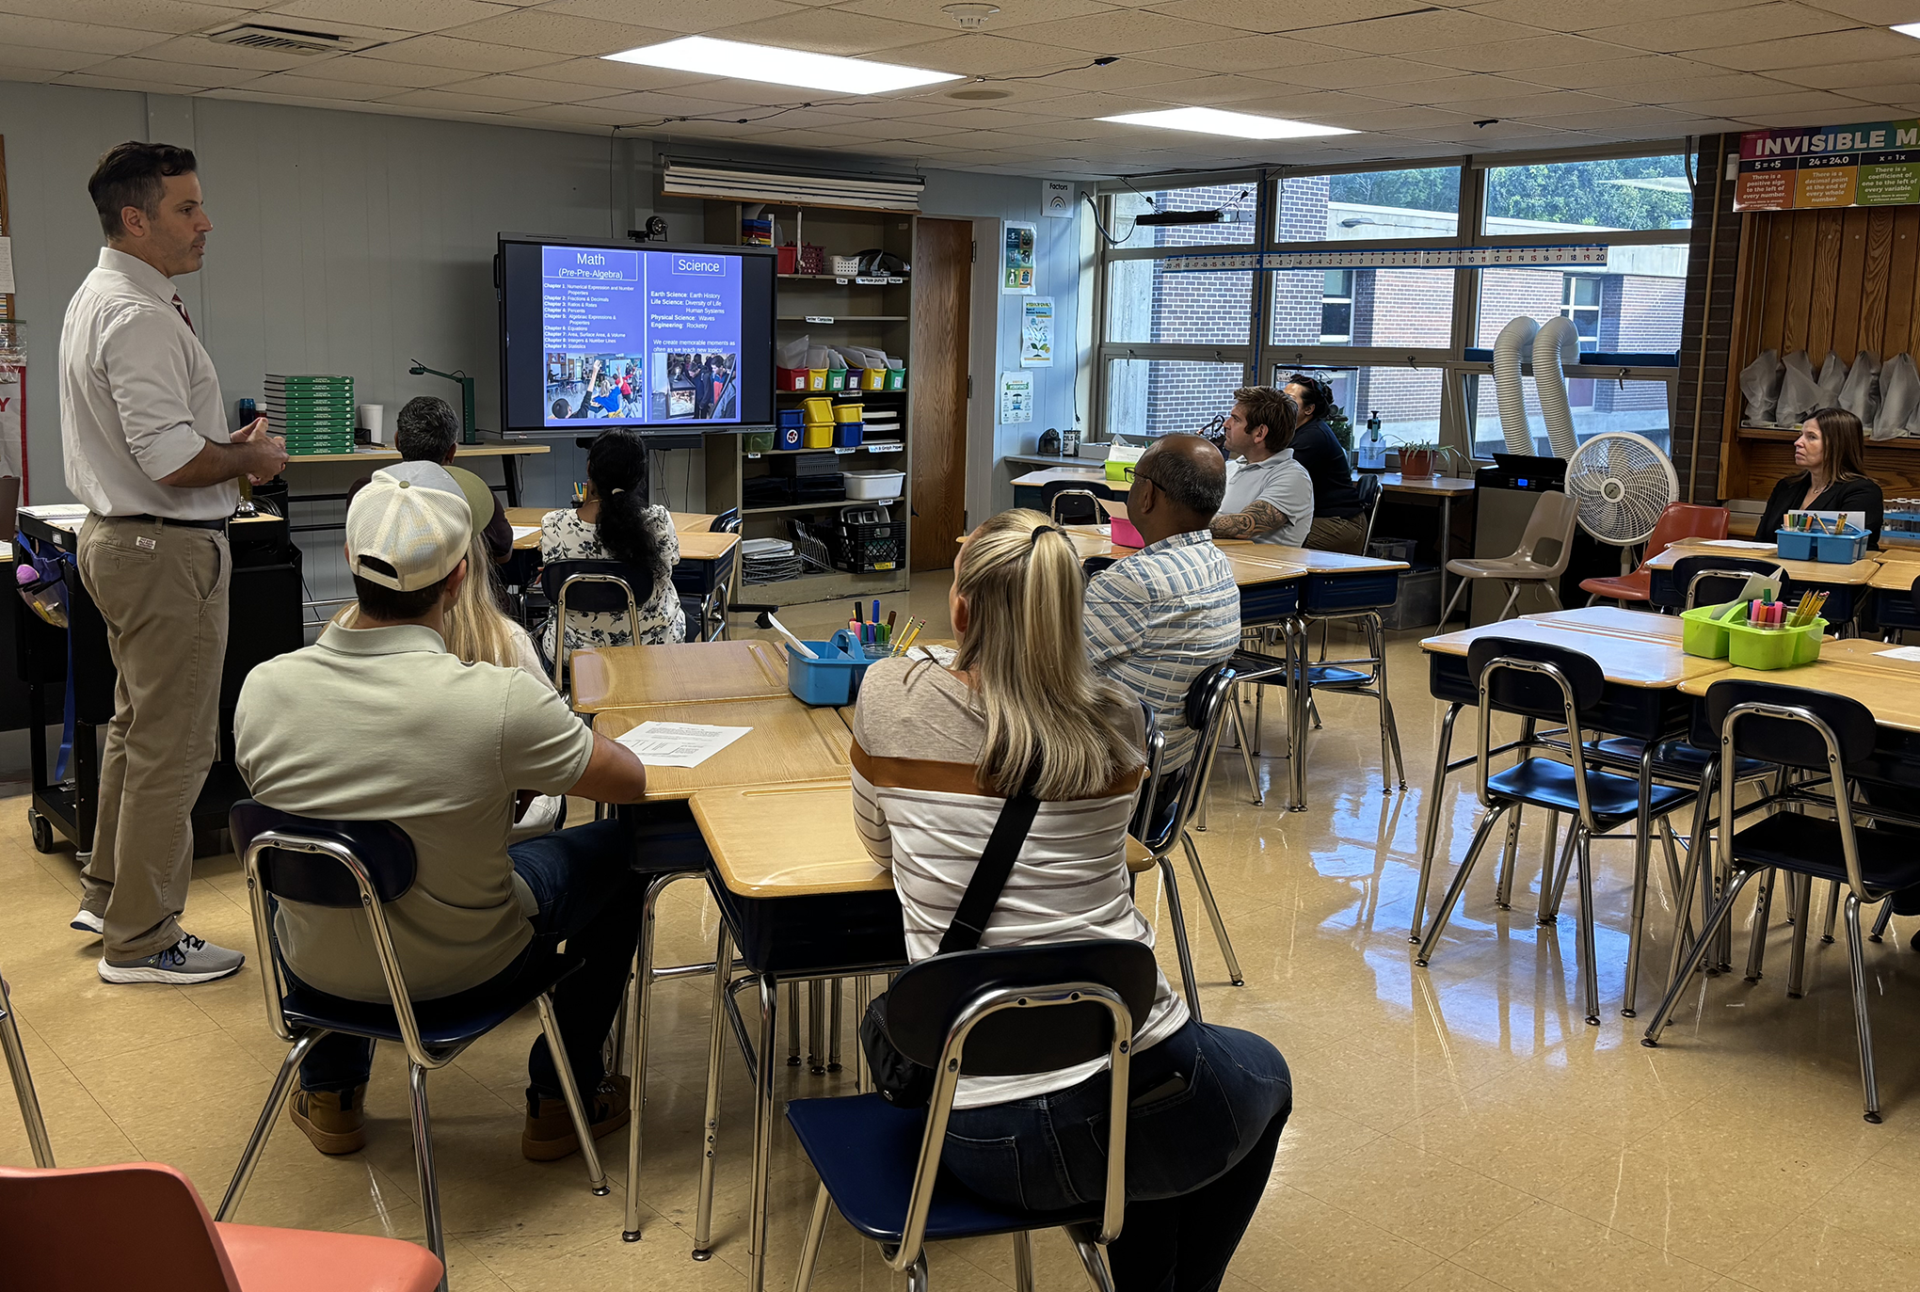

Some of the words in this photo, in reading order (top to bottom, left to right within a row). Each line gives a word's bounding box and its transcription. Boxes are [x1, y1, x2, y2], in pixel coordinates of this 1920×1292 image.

[1755, 130, 1886, 156] INVISIBLE
[1896, 128, 1920, 146] M
[1829, 156, 1849, 164] 24.0
[577, 253, 605, 265] Math
[678, 259, 720, 272] Science
[558, 268, 623, 280] (Pre-Pre-Algebra)
